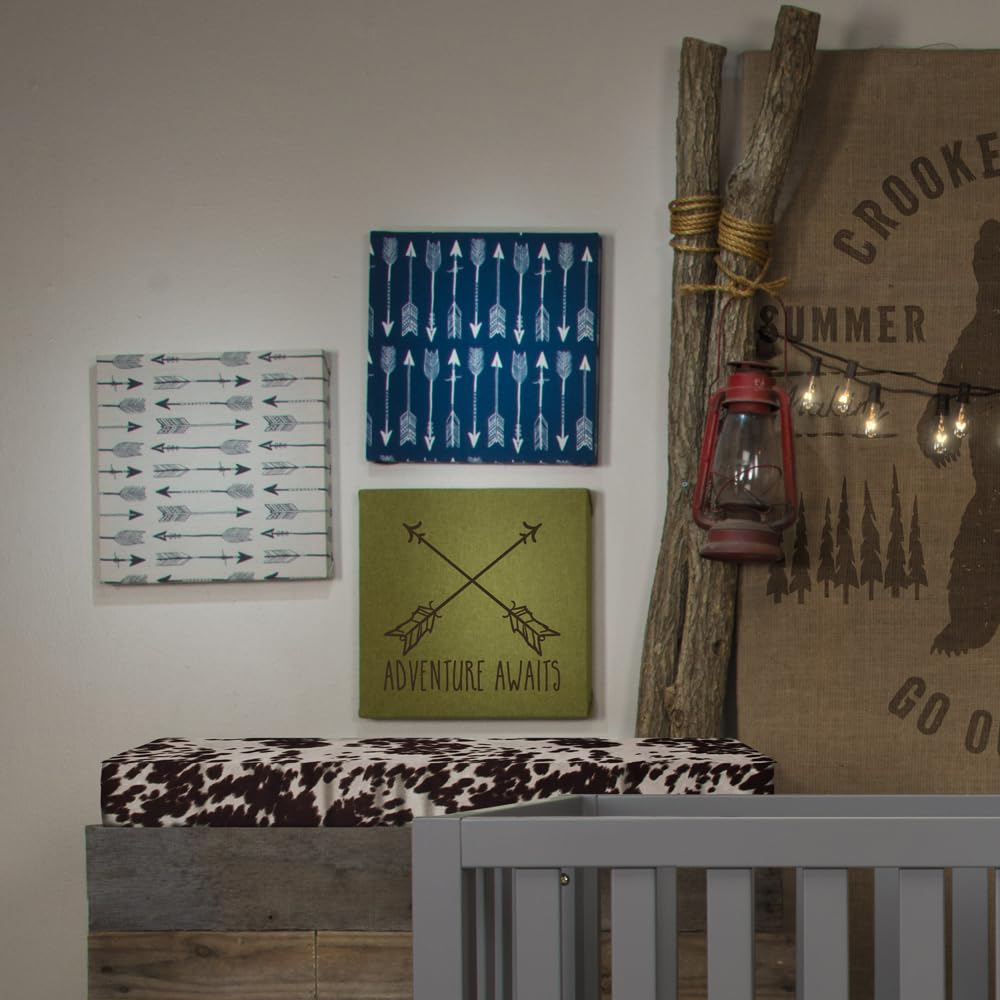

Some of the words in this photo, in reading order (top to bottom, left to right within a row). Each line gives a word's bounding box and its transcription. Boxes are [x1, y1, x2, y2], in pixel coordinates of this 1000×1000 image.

[760, 304, 926, 344] SUMMER
[384, 660, 485, 692] ADVENTURE
[495, 660, 561, 692] AWAITS
[888, 676, 951, 735] GO
